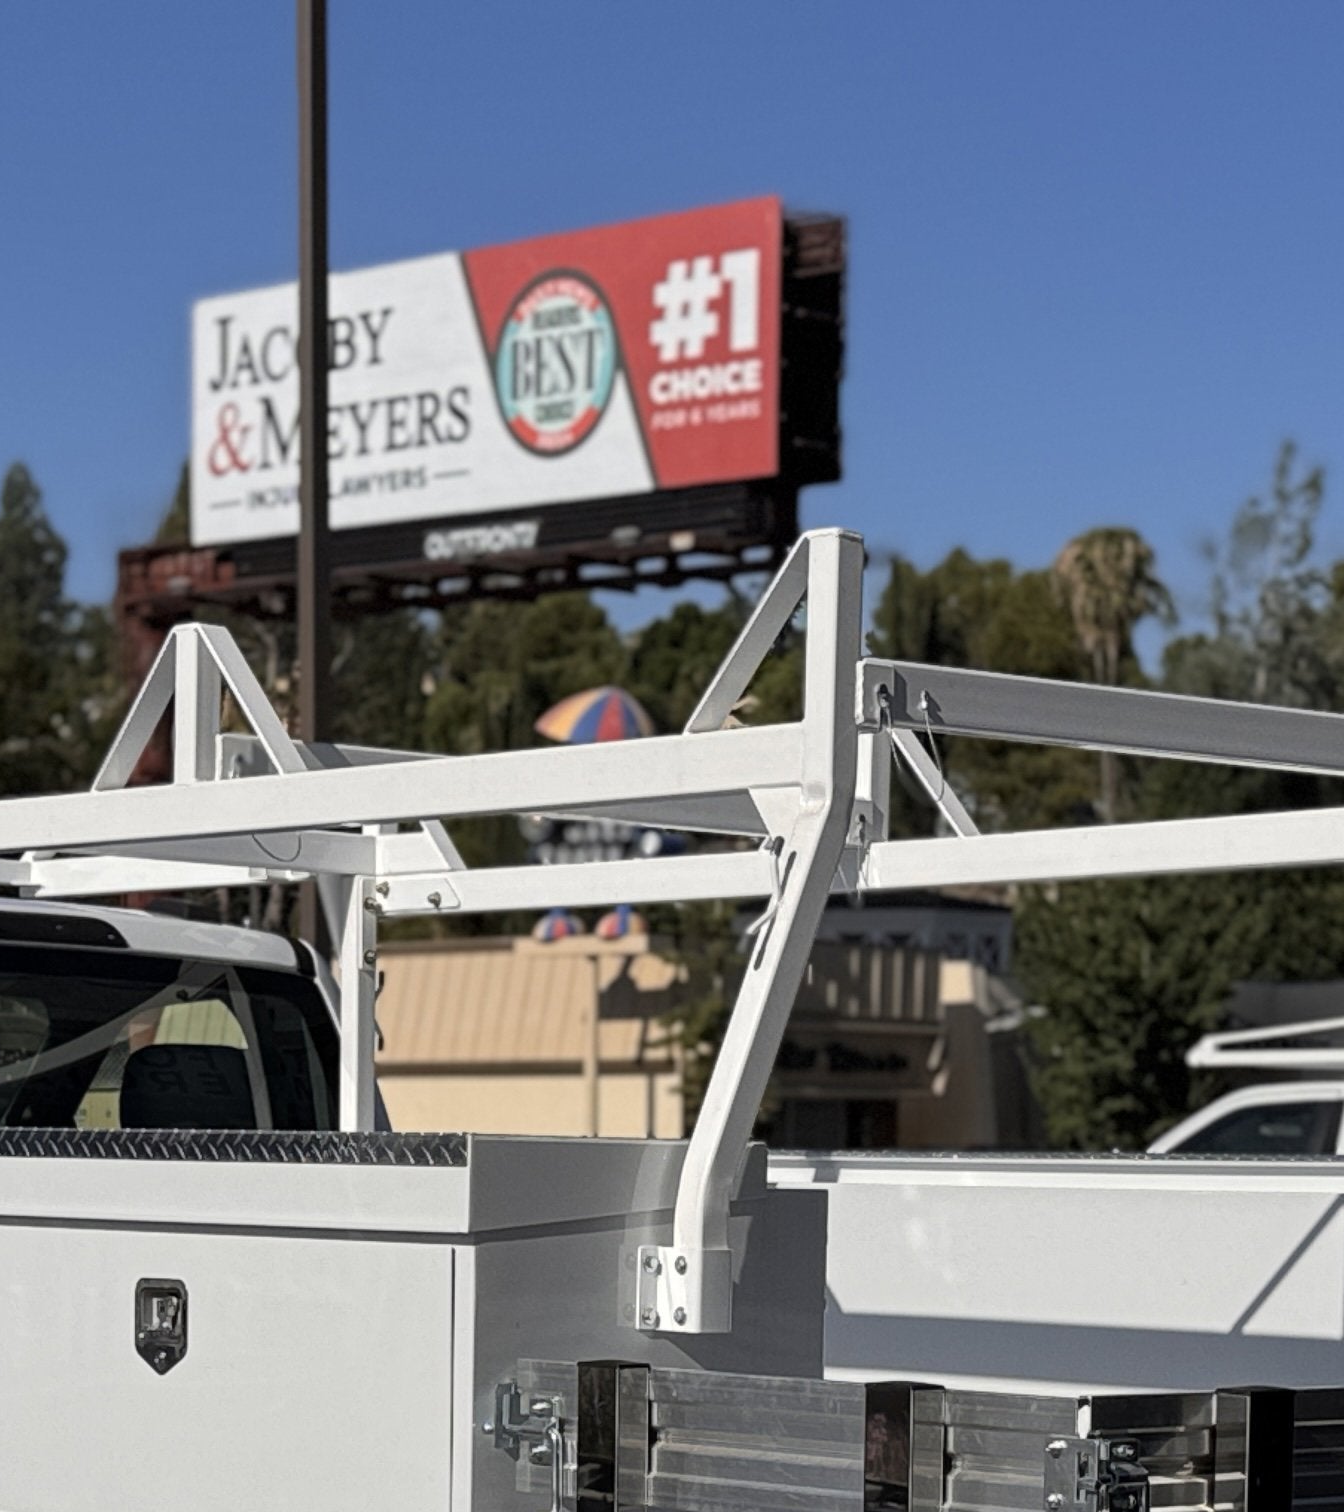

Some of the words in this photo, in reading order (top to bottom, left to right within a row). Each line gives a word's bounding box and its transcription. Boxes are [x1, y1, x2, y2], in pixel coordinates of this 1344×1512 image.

[650, 248, 761, 364] #1
[208, 306, 393, 394] JACBY
[511, 325, 604, 402] BEST
[649, 360, 762, 405] CHOICE
